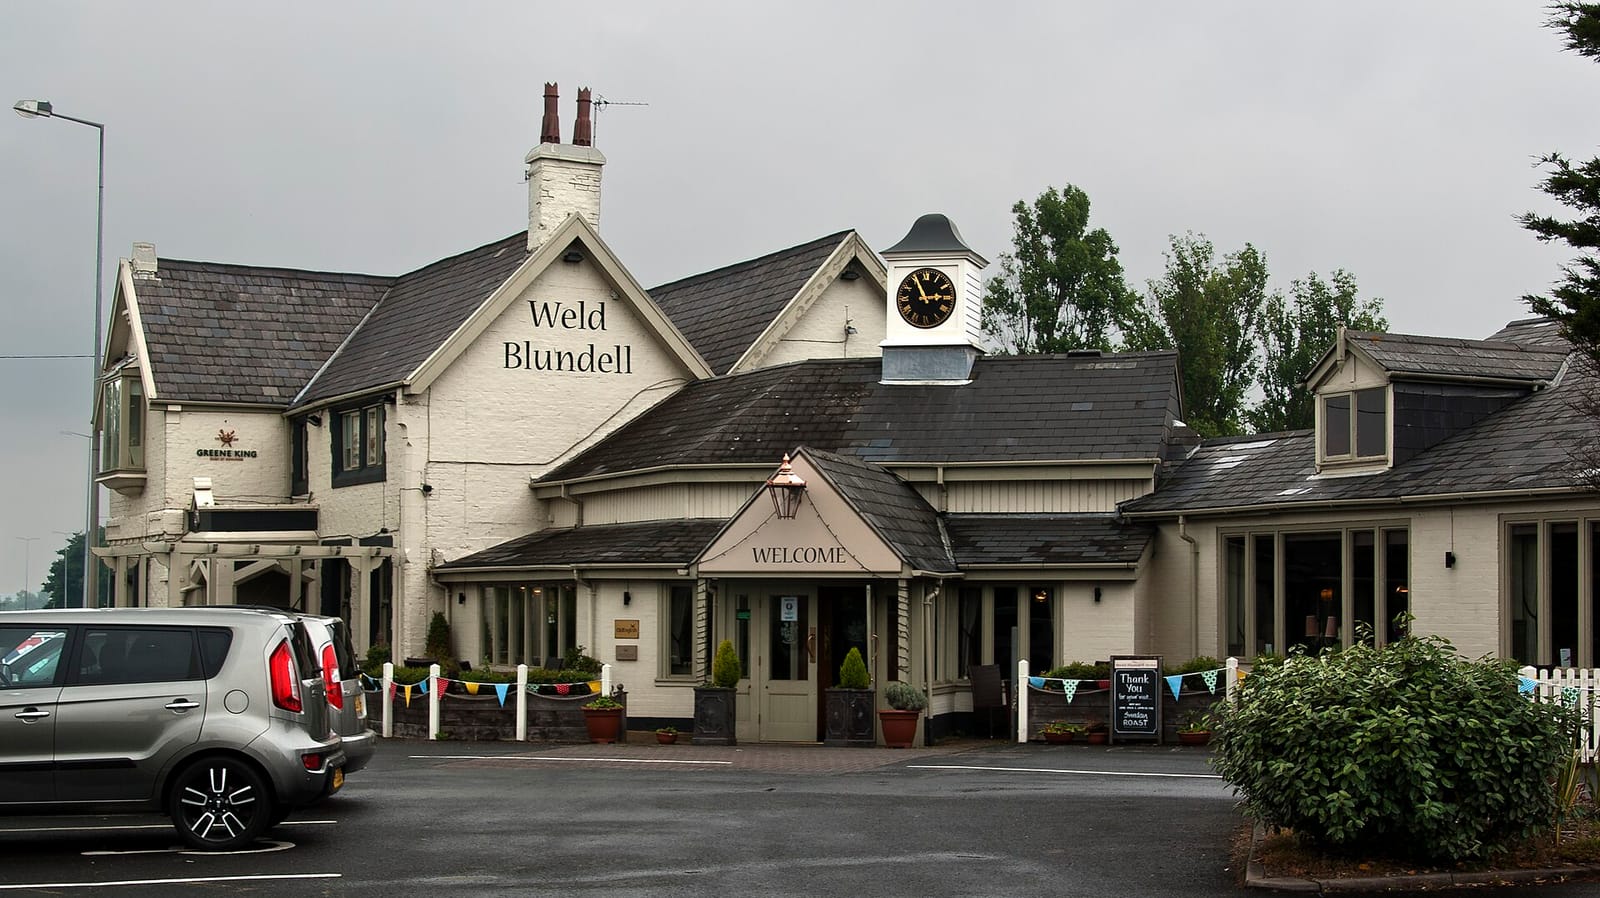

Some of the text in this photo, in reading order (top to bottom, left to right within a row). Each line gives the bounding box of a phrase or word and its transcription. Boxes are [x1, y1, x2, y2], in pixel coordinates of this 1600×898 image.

[528, 300, 607, 331] Weld
[503, 341, 633, 374] Blundell
[196, 449, 257, 458] GREENE KING
[752, 547, 847, 563] WELCOME
[1120, 673, 1149, 684] Thank
[1126, 684, 1142, 693] You
